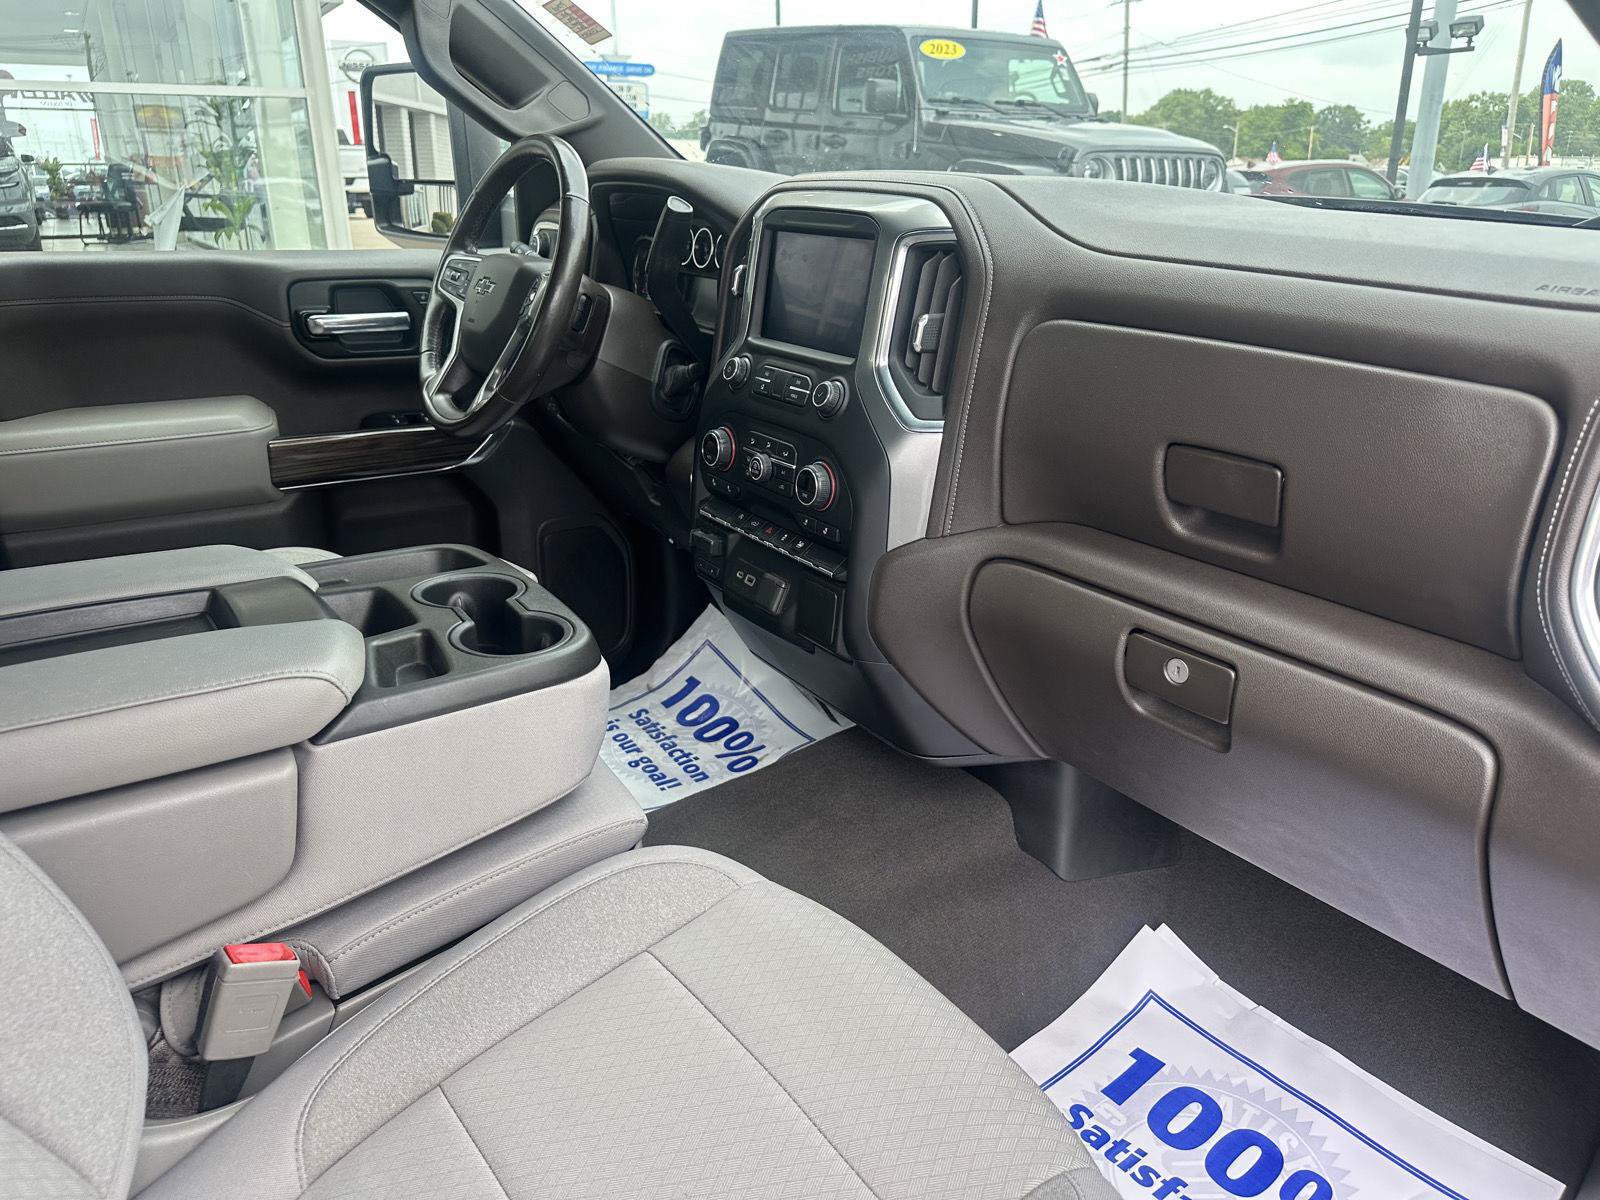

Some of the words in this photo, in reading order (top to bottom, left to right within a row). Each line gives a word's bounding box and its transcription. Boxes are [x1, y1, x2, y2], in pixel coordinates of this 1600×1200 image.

[929, 43, 957, 55] 2023
[612, 733, 643, 754] our
[628, 757, 682, 791] goal!
[628, 708, 709, 783] Satisfaction
[661, 676, 766, 772] 100%
[1065, 1103, 1193, 1200] Satisf
[1100, 1047, 1333, 1200] 100
